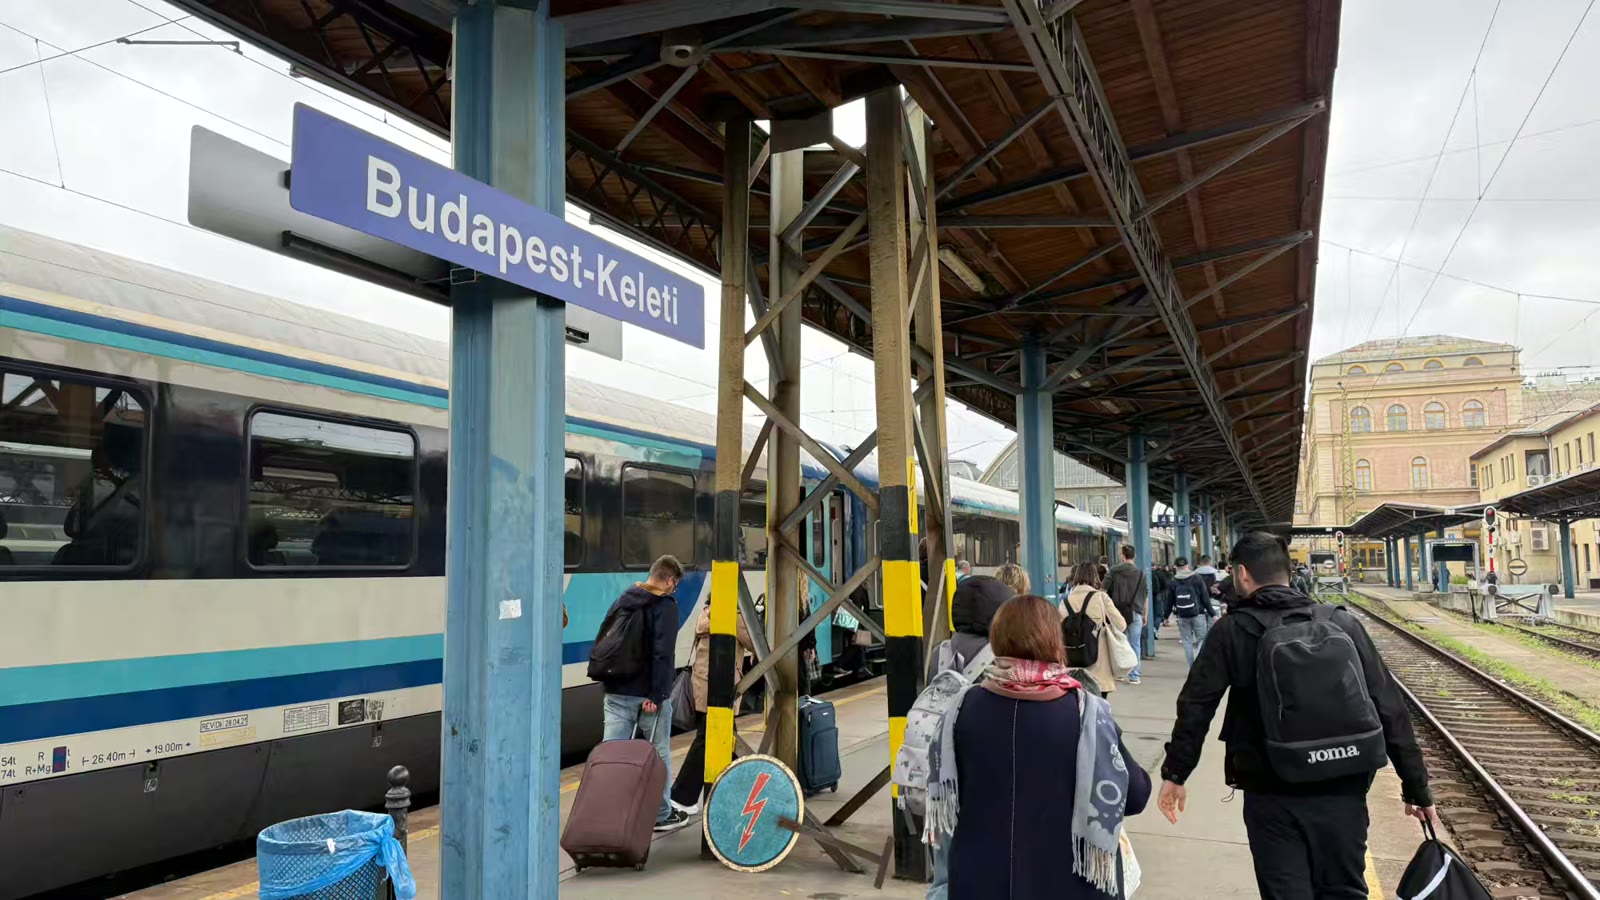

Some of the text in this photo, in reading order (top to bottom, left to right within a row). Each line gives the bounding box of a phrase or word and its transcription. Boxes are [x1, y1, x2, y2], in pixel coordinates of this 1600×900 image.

[366, 155, 679, 325] Budapest-Keleti
[154, 743, 183, 754] 19.00m
[38, 752, 45, 761] R
[92, 752, 126, 765] 26.40m
[25, 764, 51, 775] R+Mg
